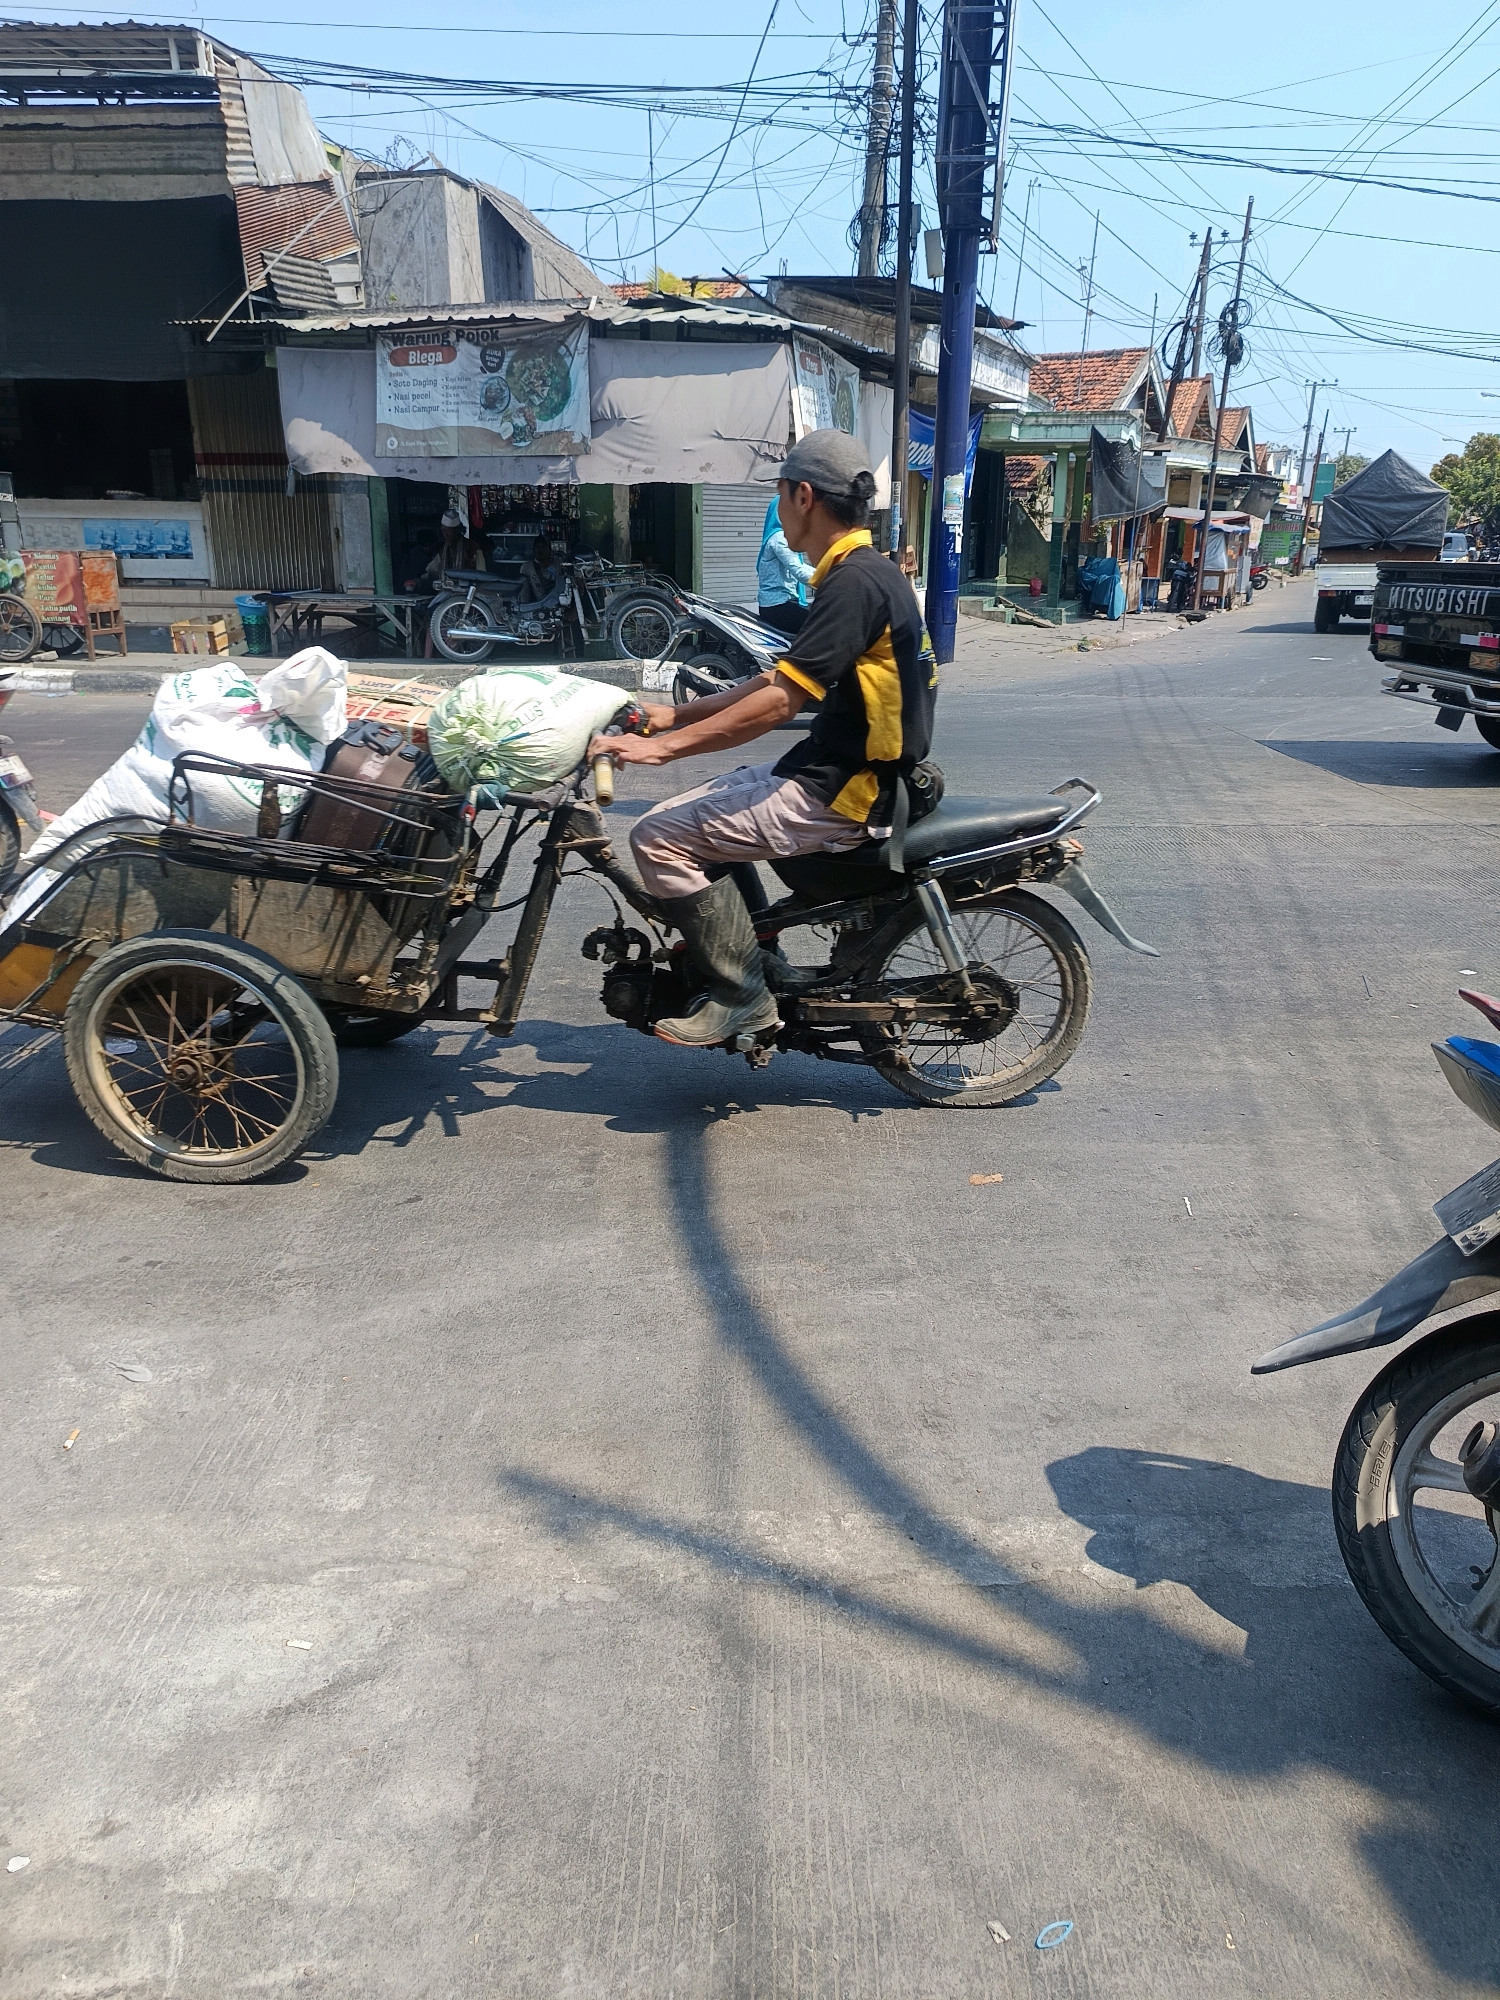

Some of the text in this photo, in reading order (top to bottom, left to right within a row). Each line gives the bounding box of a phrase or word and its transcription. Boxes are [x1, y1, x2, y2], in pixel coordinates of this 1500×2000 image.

[392, 327, 499, 347] Warung Pojok
[408, 351, 443, 366] Blega
[393, 379, 438, 388] Soto Daging
[412, 391, 431, 401] pecel
[412, 405, 440, 414] Campur
[1388, 586, 1490, 615] MITSUBISHI
